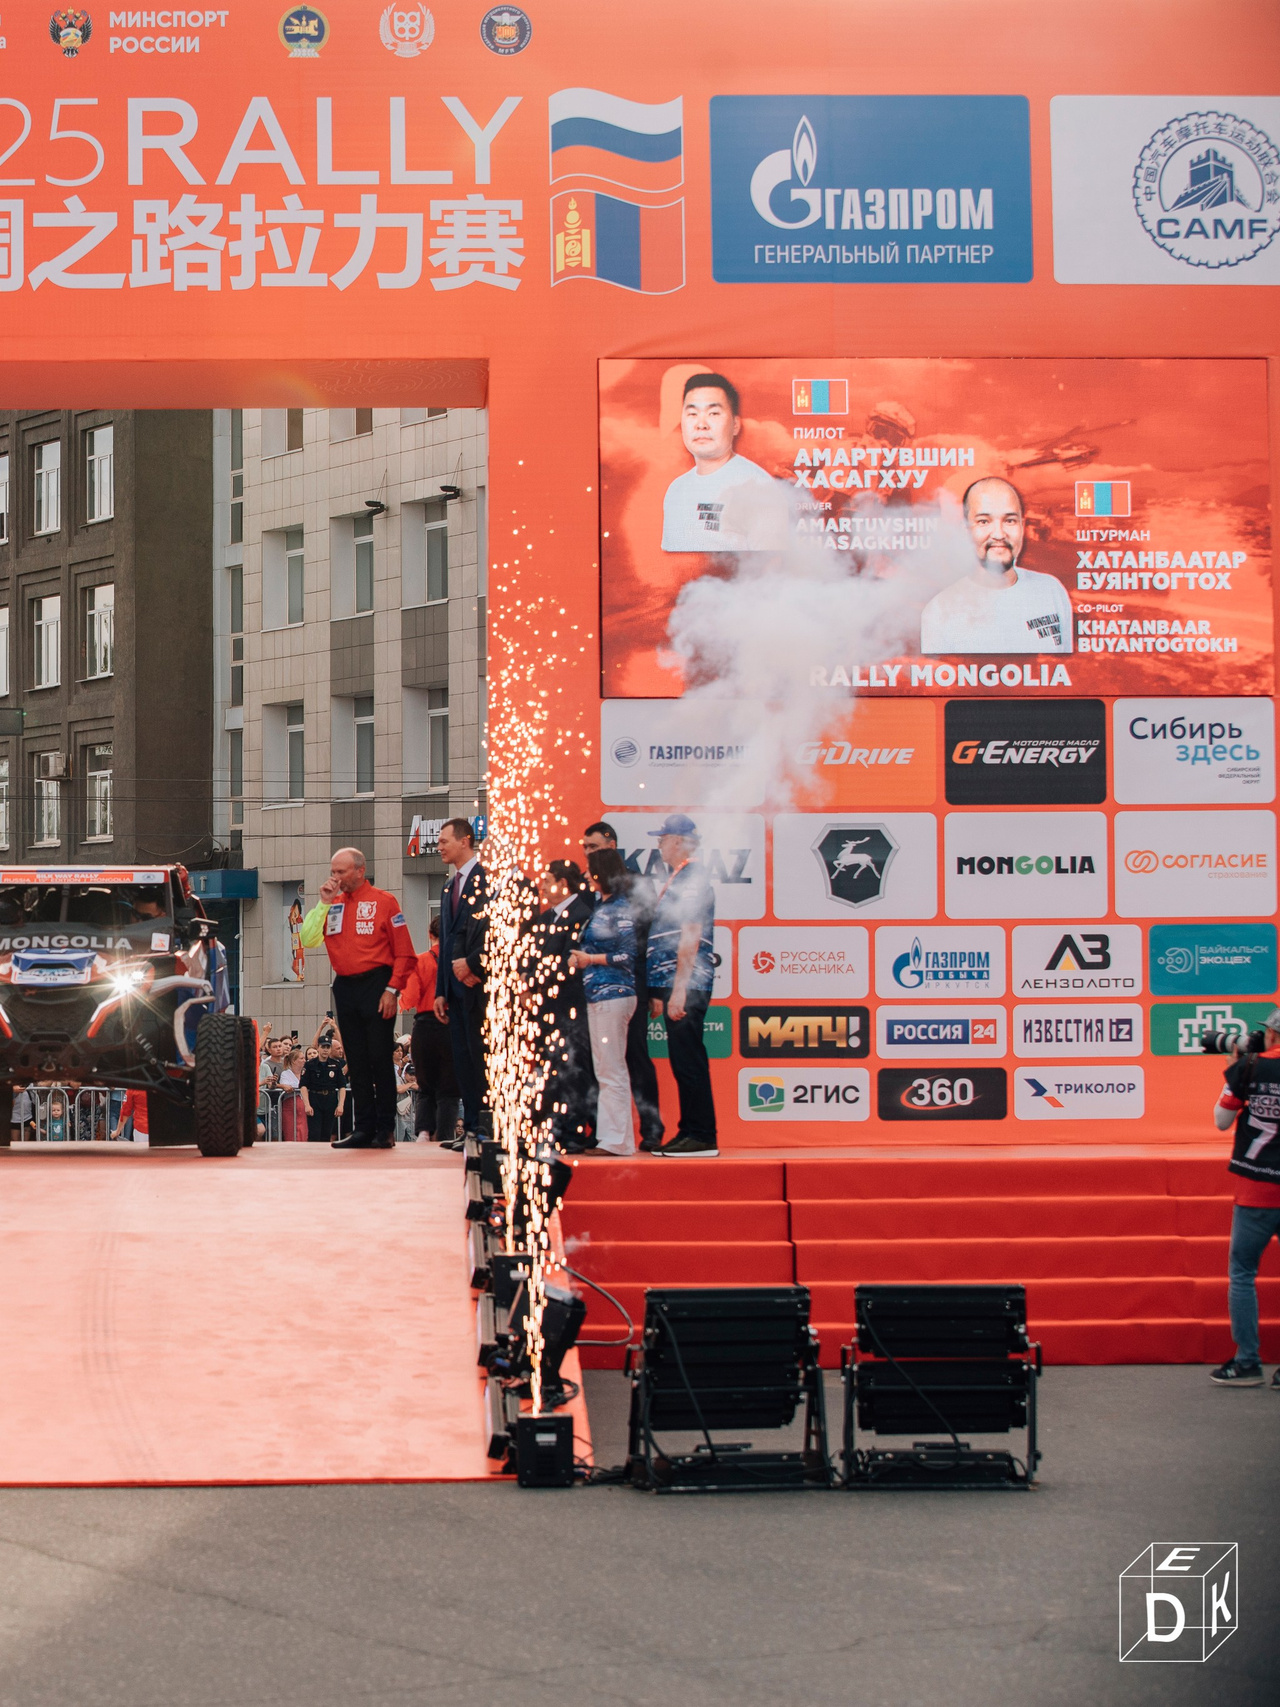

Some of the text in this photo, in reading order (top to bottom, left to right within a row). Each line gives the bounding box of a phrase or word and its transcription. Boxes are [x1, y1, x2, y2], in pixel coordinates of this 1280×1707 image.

[109, 10, 229, 29] МИНСПОРТ
[109, 36, 201, 54] РОССИИ
[126, 95, 524, 187] RALLY
[824, 188, 994, 230] ГАЗПРОМ
[1156, 218, 1268, 239] CAMF
[753, 242, 994, 265] ГЕНЕРАЛЬНЫЙ ПАРТНЕР
[793, 427, 846, 440] ПИЛОТ
[793, 448, 975, 467] АМАРТУВШИН
[793, 469, 929, 489] ХАСАГХУУ
[794, 502, 833, 511] DRIVER
[796, 517, 939, 533] AMARTUVSHIN
[1075, 529, 1151, 542] ШТУРМАН
[1075, 550, 1247, 569] ХАТАНБААТАР
[1076, 572, 1232, 590] БУЯНТОГТОХ
[1077, 603, 1124, 614] CO-PILOT
[1077, 619, 1212, 635] KHATANBAAR
[1077, 637, 1238, 653] BUYANTOGTOKH
[809, 664, 1072, 688] RALLY MONGOLIA
[1129, 716, 1243, 745] Сибирь
[649, 745, 744, 760] ГАЗПРОМБАН
[1175, 744, 1261, 766] здесь
[618, 848, 752, 884] KAAZ
[956, 855, 1096, 876] MONGOLIA
[1162, 854, 1268, 869] СОГЛАСИЕ
[1207, 871, 1268, 879] страхование
[780, 951, 846, 962] РУССКАЯ
[1198, 945, 1269, 954] БАЙКАЛЬСК
[925, 951, 990, 968] ГАЗПРОМ
[1199, 956, 1252, 965] ЭКО.ЦЕХ
[780, 963, 855, 975] МЕХАНИКА
[926, 970, 989, 980] ДОБЫЧА
[924, 981, 990, 989] ИРКУТСК
[1021, 977, 1135, 989] ЛЕНЗОЛОТО
[747, 1016, 862, 1049] МАТЧ!
[893, 1024, 996, 1040] РОССИЯ 24
[1023, 1018, 1104, 1043] ИЗВЕСТИЯ
[792, 1084, 860, 1104] 2ГИС
[911, 1077, 975, 1106] 360
[1054, 1082, 1137, 1095] ТРИКОЛОР
[1246, 1114, 1279, 1161] 7
